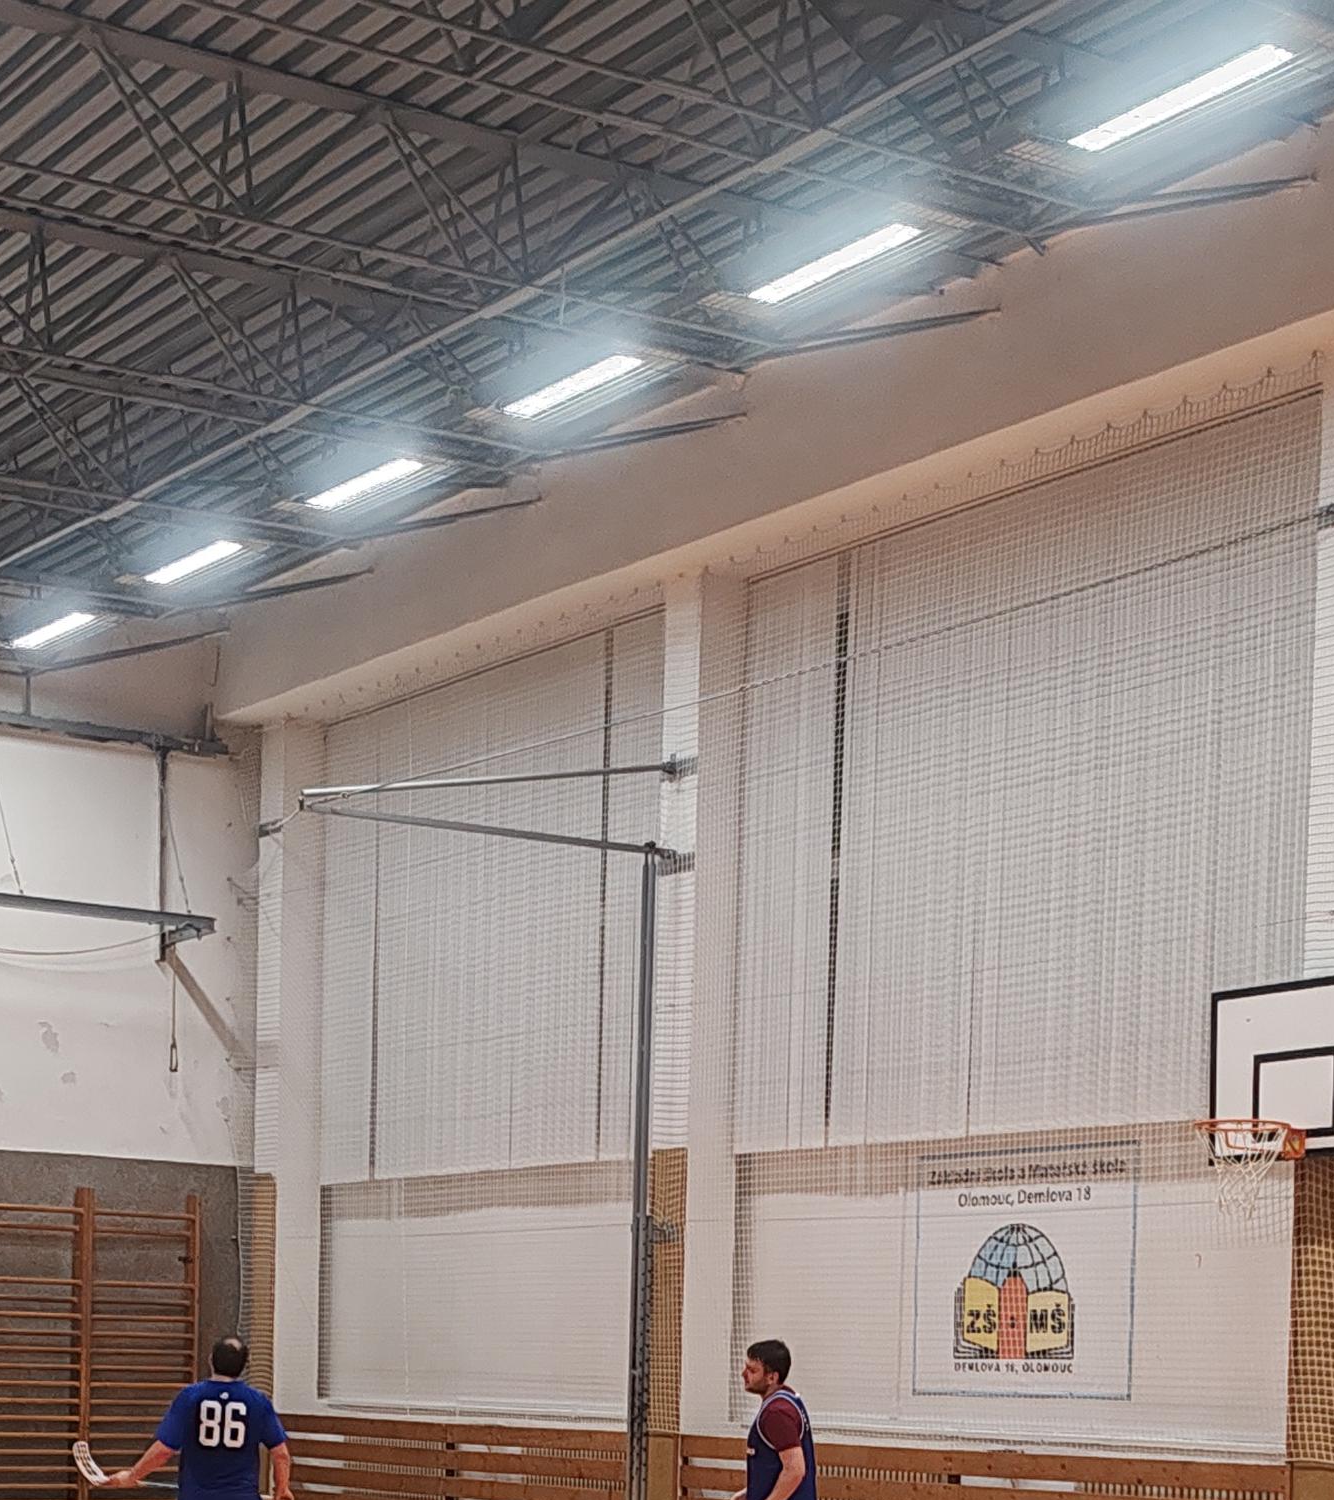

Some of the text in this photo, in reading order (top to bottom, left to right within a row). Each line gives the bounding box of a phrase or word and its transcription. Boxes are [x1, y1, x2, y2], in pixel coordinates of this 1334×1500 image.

[1017, 1187, 1072, 1205] Demlova
[1076, 1185, 1091, 1201] 18
[967, 1304, 997, 1334] ZŠ
[1030, 1303, 1066, 1334] MŠ
[199, 1400, 247, 1448] 86
